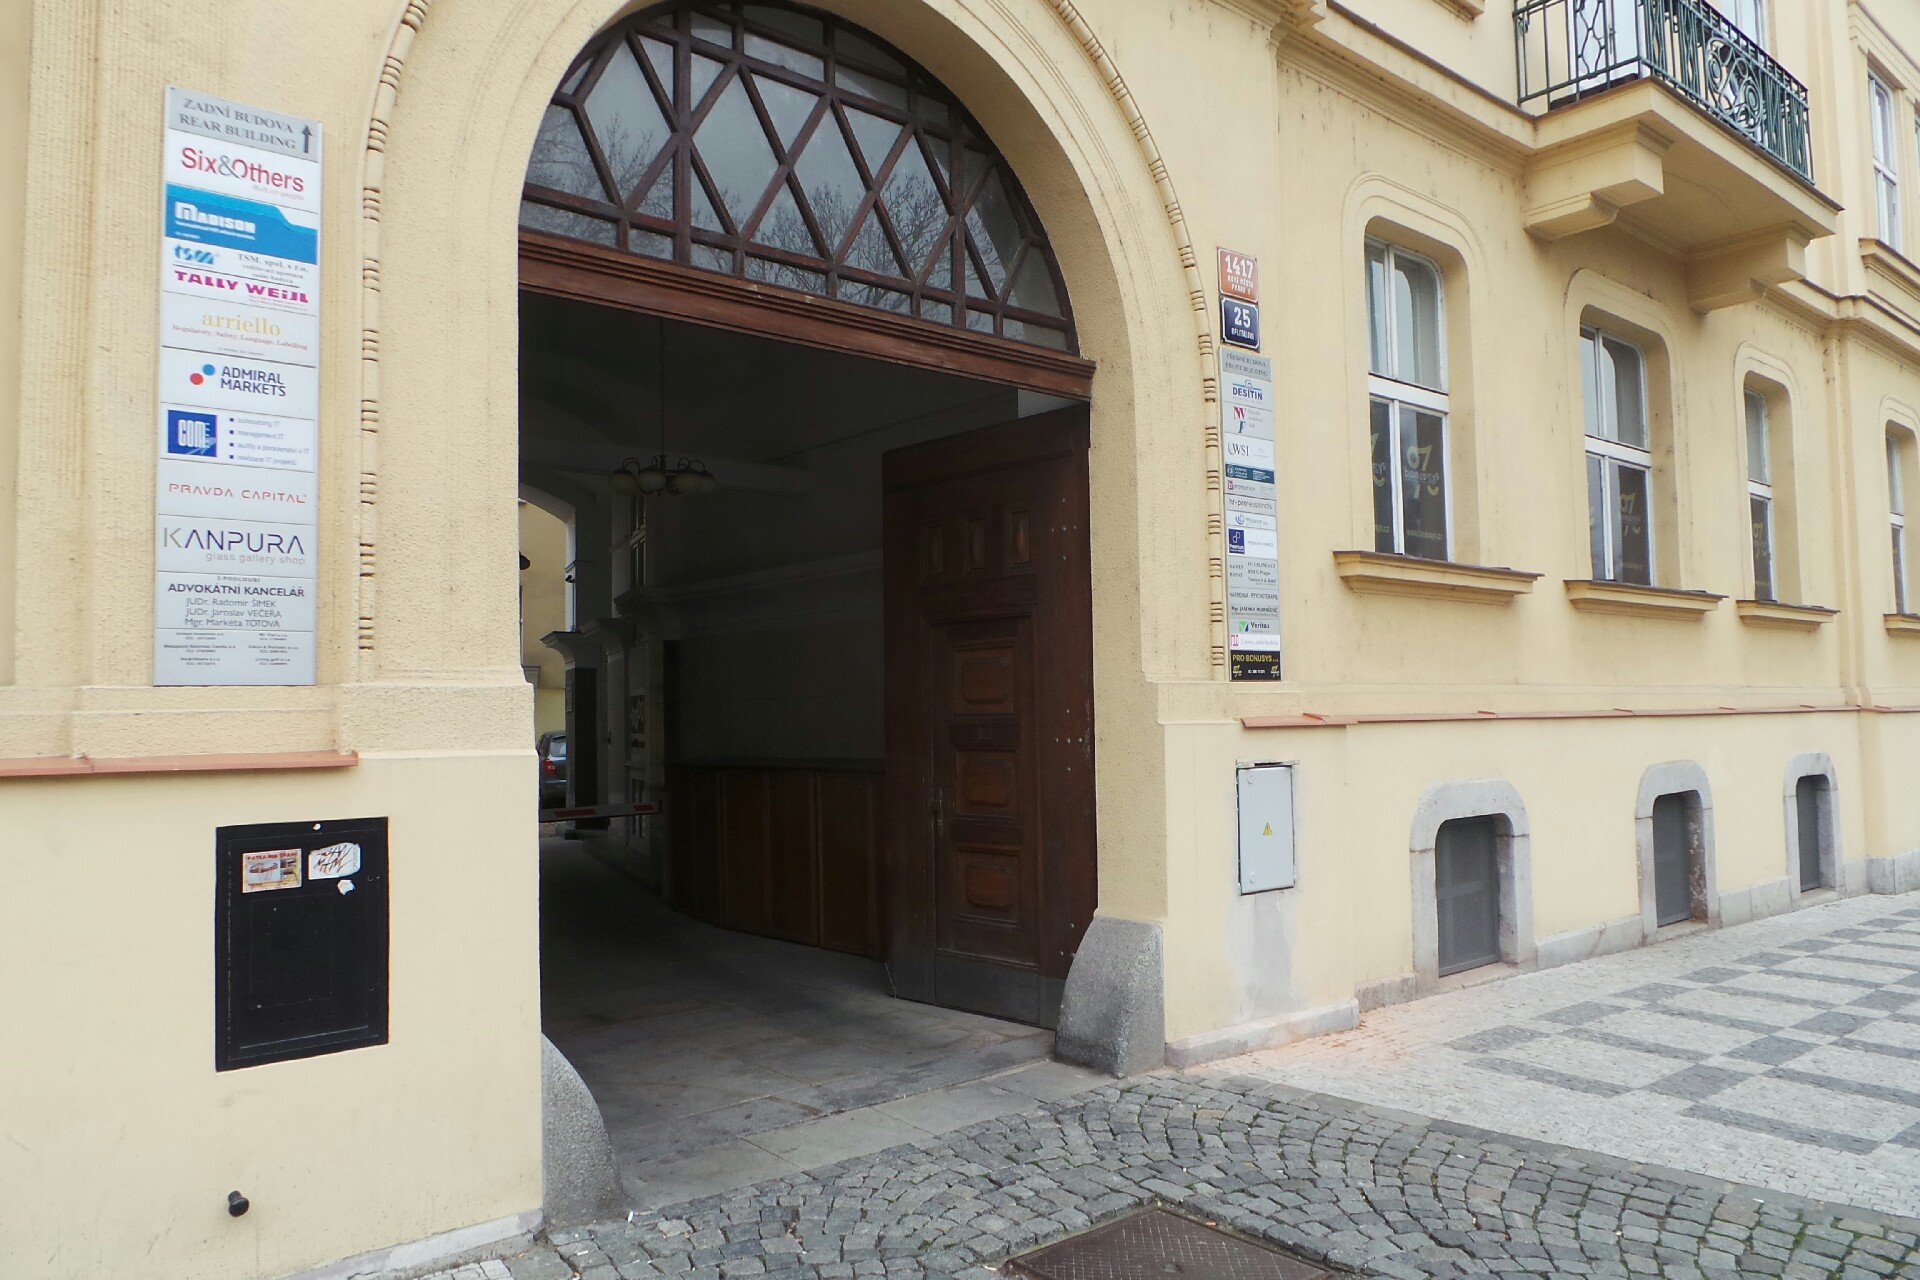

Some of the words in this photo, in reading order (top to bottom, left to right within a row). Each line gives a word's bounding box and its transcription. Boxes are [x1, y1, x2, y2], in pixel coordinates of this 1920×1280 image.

[183, 97, 231, 118] ZADNÍ
[234, 110, 293, 134] BUDOVA
[179, 113, 222, 132] REAR
[225, 125, 296, 149] BUILDING
[181, 147, 304, 192] Six&Others
[1224, 254, 1254, 279] 1417
[174, 270, 239, 291] TALLY
[202, 314, 282, 337] arriello
[1233, 306, 1251, 328] 25
[221, 366, 284, 385] ADMIRAL
[220, 378, 287, 397] MARKETS
[1232, 386, 1263, 401] DESITIN
[168, 483, 234, 498] PRAVDA
[241, 489, 307, 504] CAPITAL
[163, 527, 306, 555] KANPURA
[205, 552, 235, 562] glass
[239, 554, 276, 564] gallery
[279, 555, 306, 565] shop
[168, 582, 241, 595] ADVOKÁTNÍ
[244, 586, 305, 598] KANCELÁŘ
[185, 597, 209, 607] JUDr.
[184, 618, 204, 628] Mgr.
[211, 608, 245, 618] Jaroslav
[1232, 654, 1245, 662] PRO
